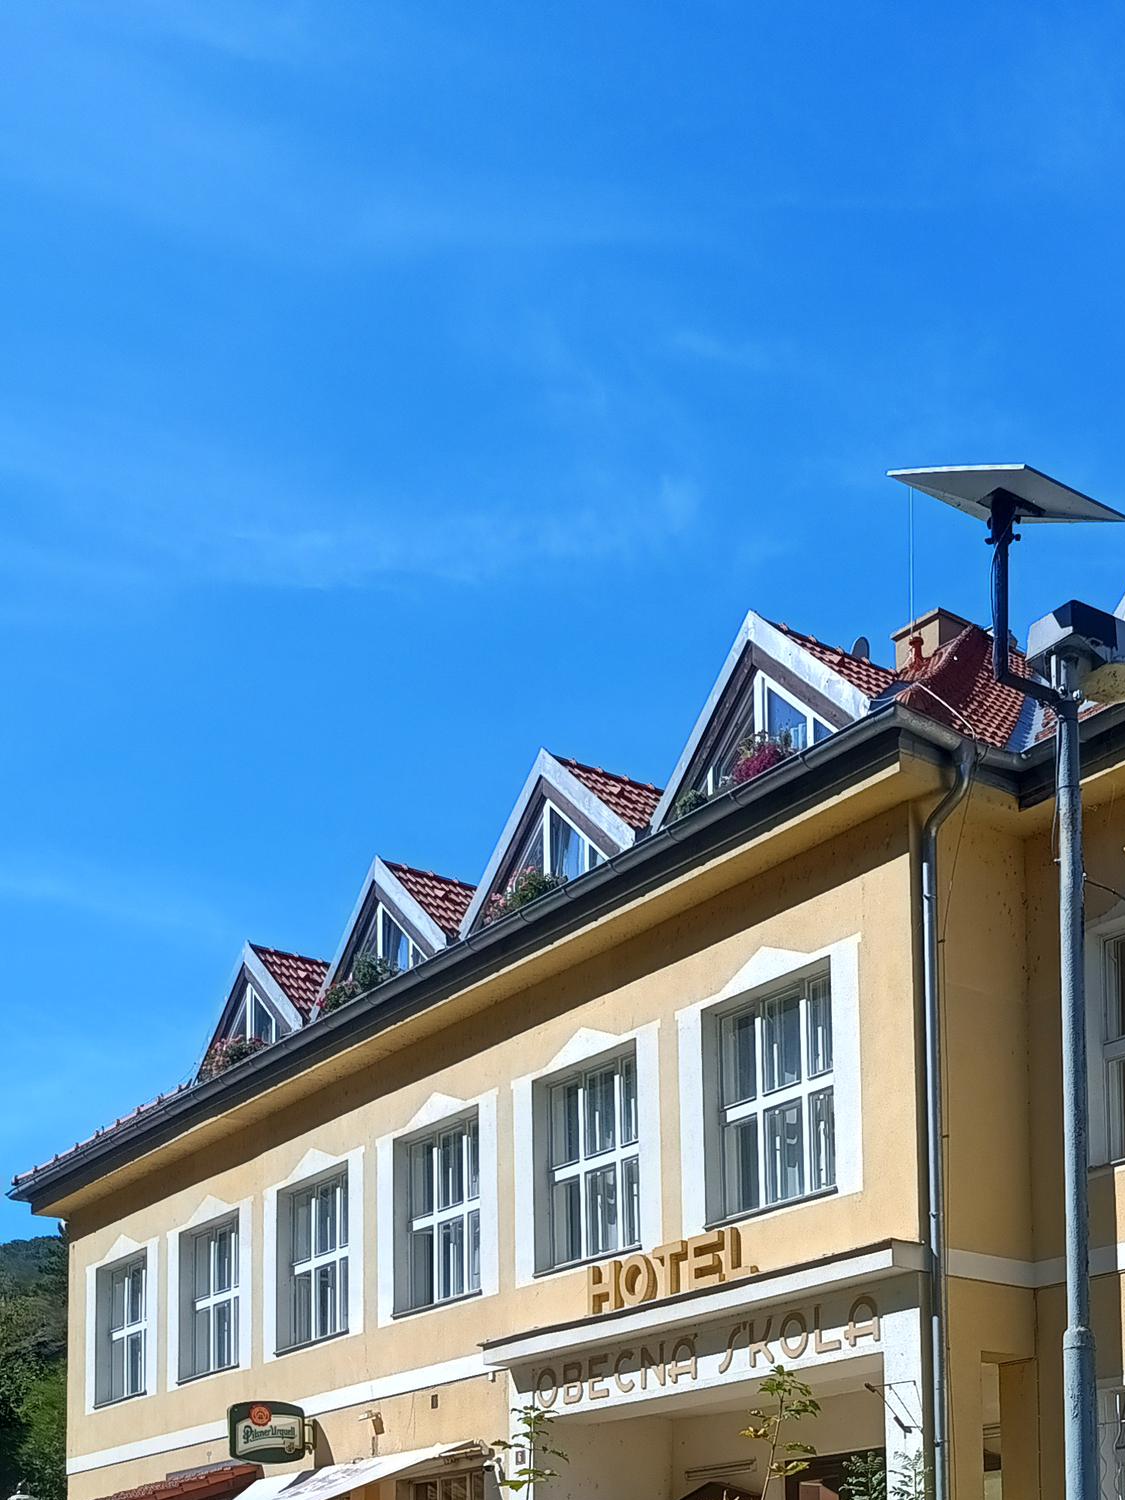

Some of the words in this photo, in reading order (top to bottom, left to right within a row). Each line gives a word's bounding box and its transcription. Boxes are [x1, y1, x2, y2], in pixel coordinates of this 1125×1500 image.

[587, 1227, 760, 1315] HOTEL
[243, 1425, 271, 1444] Pilsner
[270, 1425, 296, 1440] Urquell
